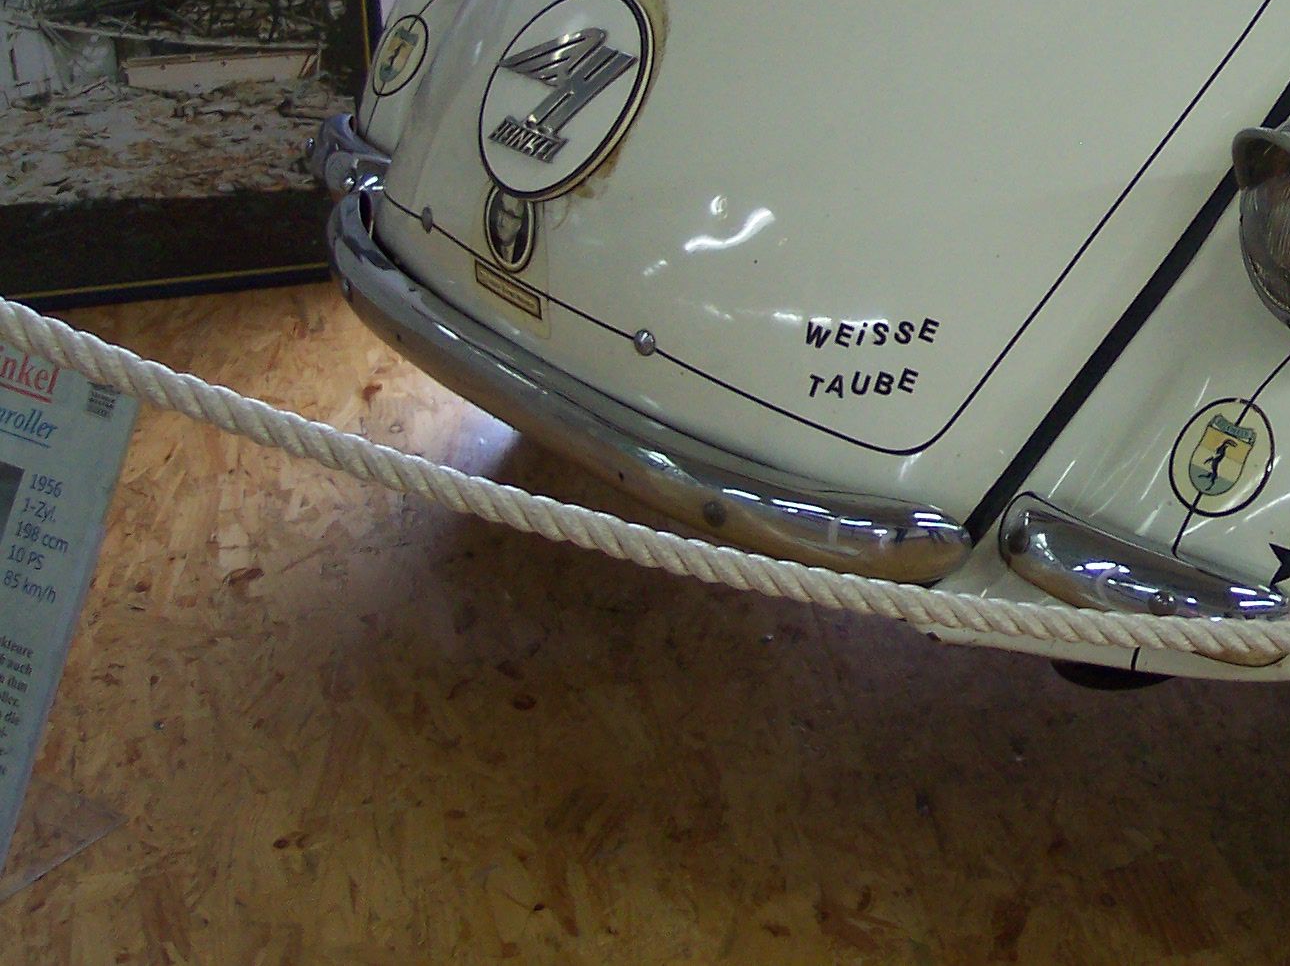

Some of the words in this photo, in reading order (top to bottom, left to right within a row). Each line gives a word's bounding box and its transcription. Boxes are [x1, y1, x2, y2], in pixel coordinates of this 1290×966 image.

[0, 350, 60, 395] nkel
[809, 367, 919, 399] TAUBE
[31, 473, 64, 498] 1956
[16, 520, 41, 542] 198
[42, 533, 69, 553] ccm
[7, 544, 26, 563] 10
[27, 551, 45, 570] PS
[3, 569, 22, 589] 85
[22, 577, 57, 604] km/h
